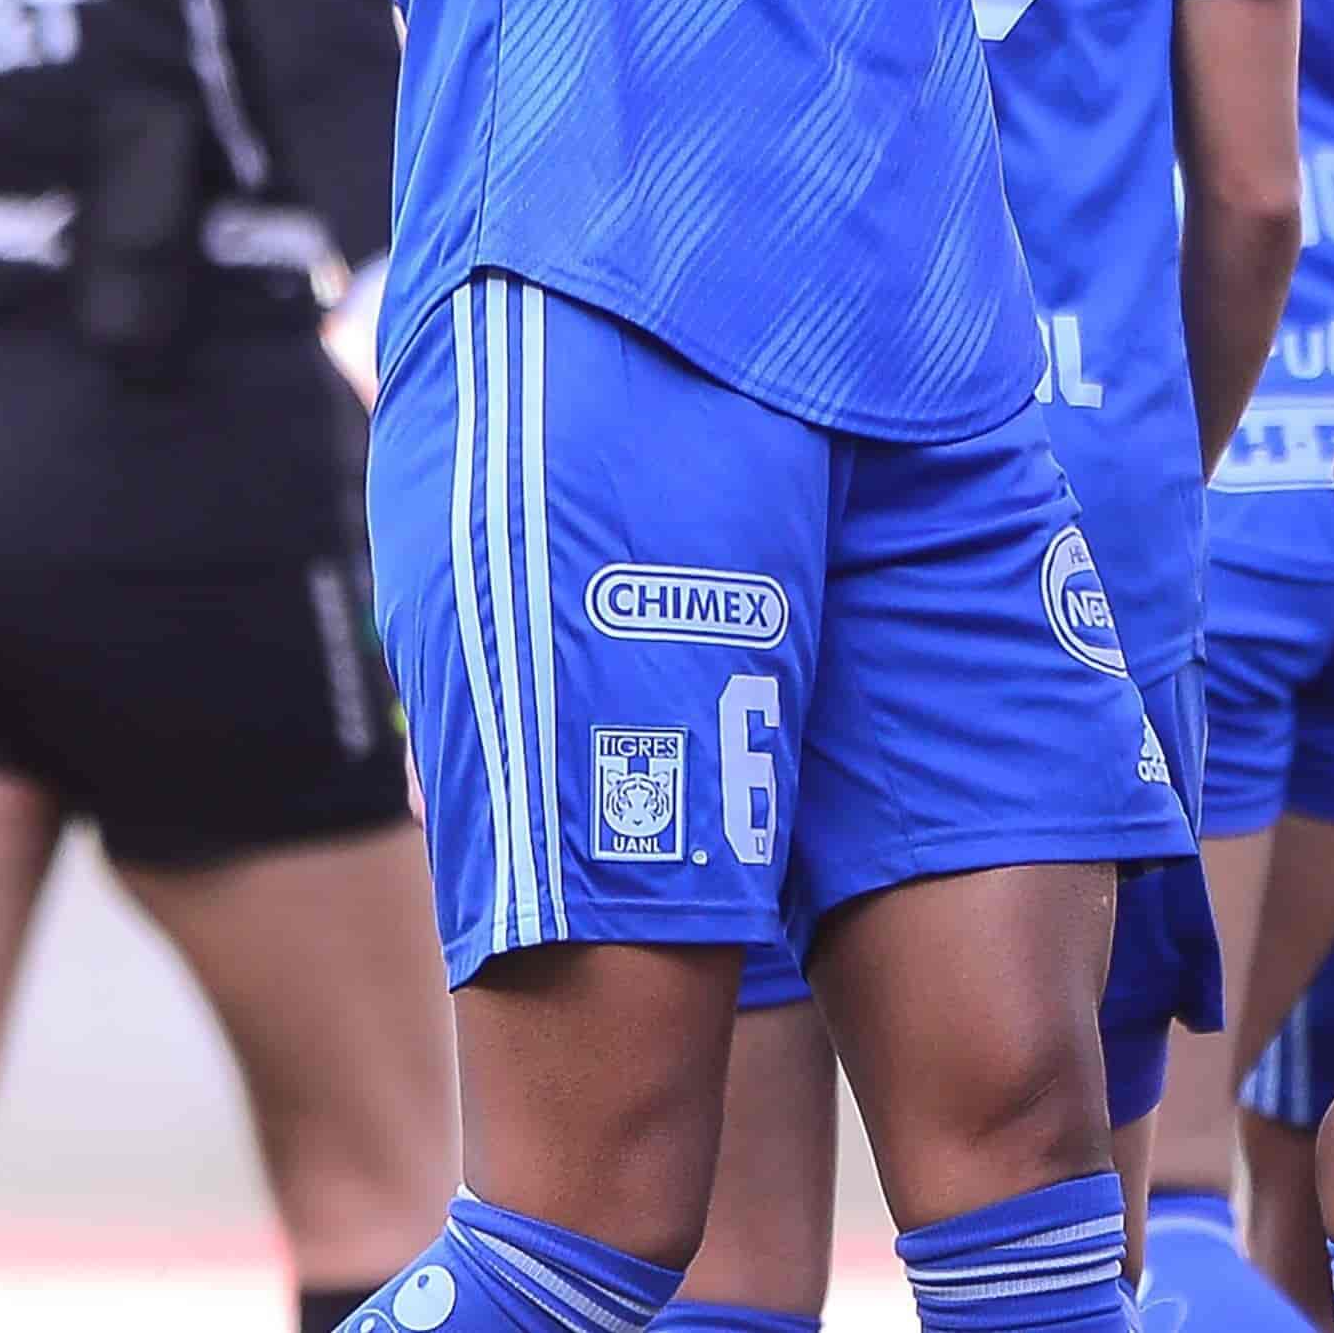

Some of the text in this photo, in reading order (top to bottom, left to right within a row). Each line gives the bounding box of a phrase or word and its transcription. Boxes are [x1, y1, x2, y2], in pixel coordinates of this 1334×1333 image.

[1034, 314, 1104, 410] L
[608, 581, 769, 628] CHIMEX
[601, 735, 677, 760] TIGRES
[718, 675, 780, 865] 6
[612, 835, 660, 855] UANL
